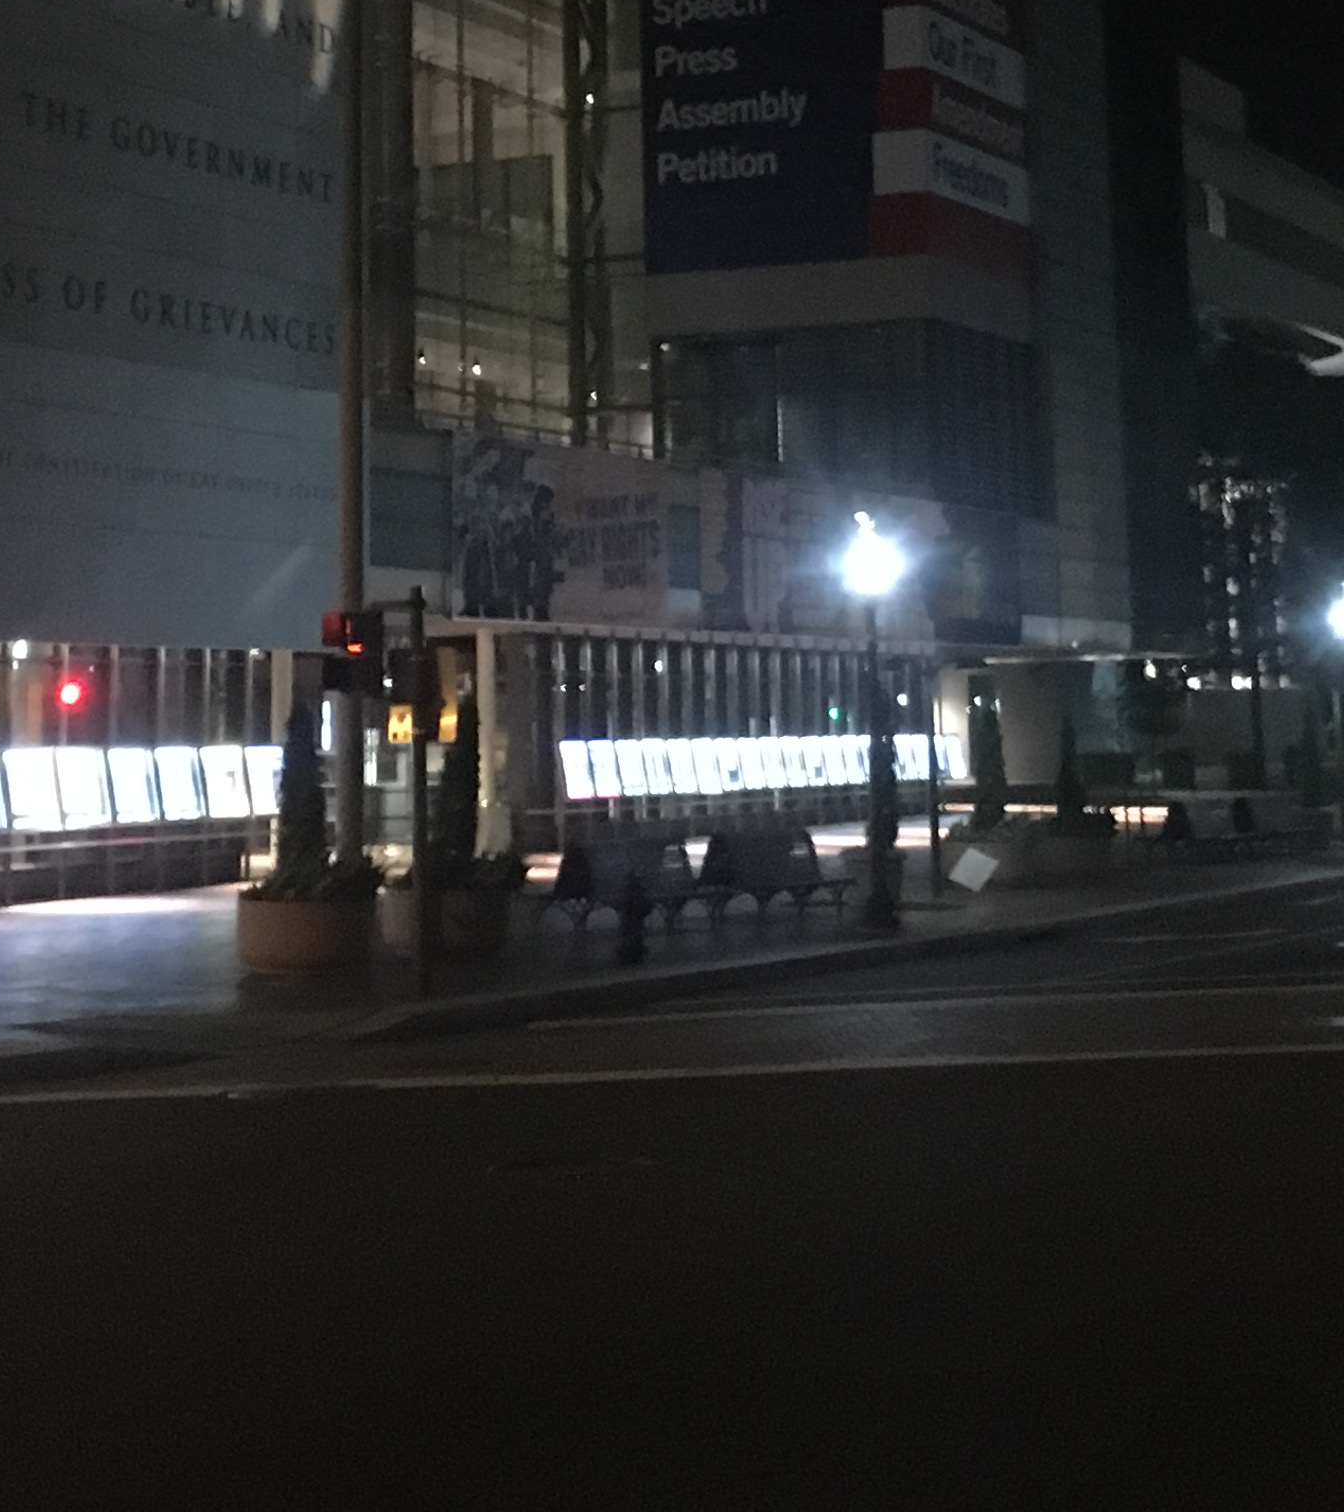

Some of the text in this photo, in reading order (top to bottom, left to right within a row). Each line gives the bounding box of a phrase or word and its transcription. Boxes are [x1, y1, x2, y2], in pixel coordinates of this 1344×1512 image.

[655, 44, 738, 78] Press
[657, 88, 808, 132] Assembly
[18, 89, 90, 141] THE
[108, 114, 335, 203] GOVERNMENT
[657, 147, 778, 186] Petition
[60, 273, 109, 315] OF
[128, 285, 338, 355] GRIEVANCES
